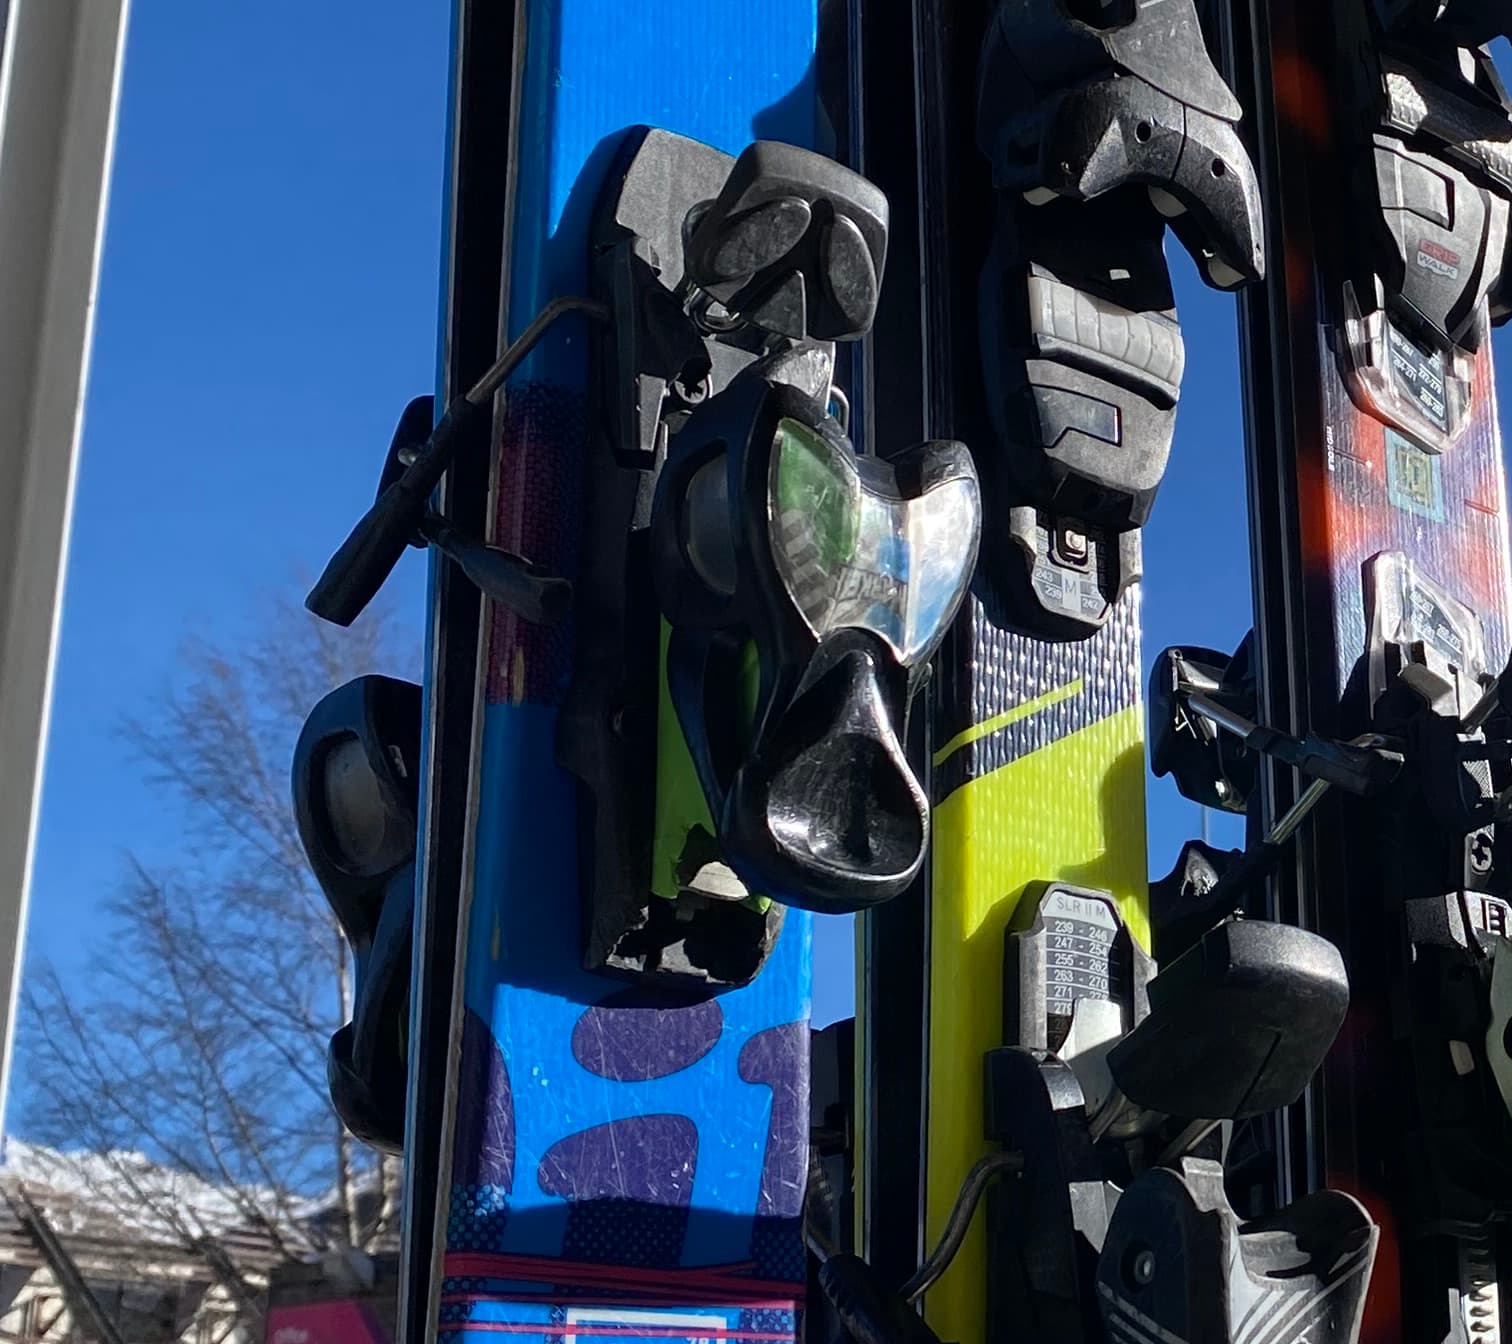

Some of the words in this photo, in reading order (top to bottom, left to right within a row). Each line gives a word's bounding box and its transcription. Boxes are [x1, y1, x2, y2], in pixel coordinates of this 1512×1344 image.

[1418, 253, 1457, 275] WALK
[1056, 896, 1081, 913] SLR
[1054, 937, 1073, 949] 247
[1054, 986, 1073, 998] 271
